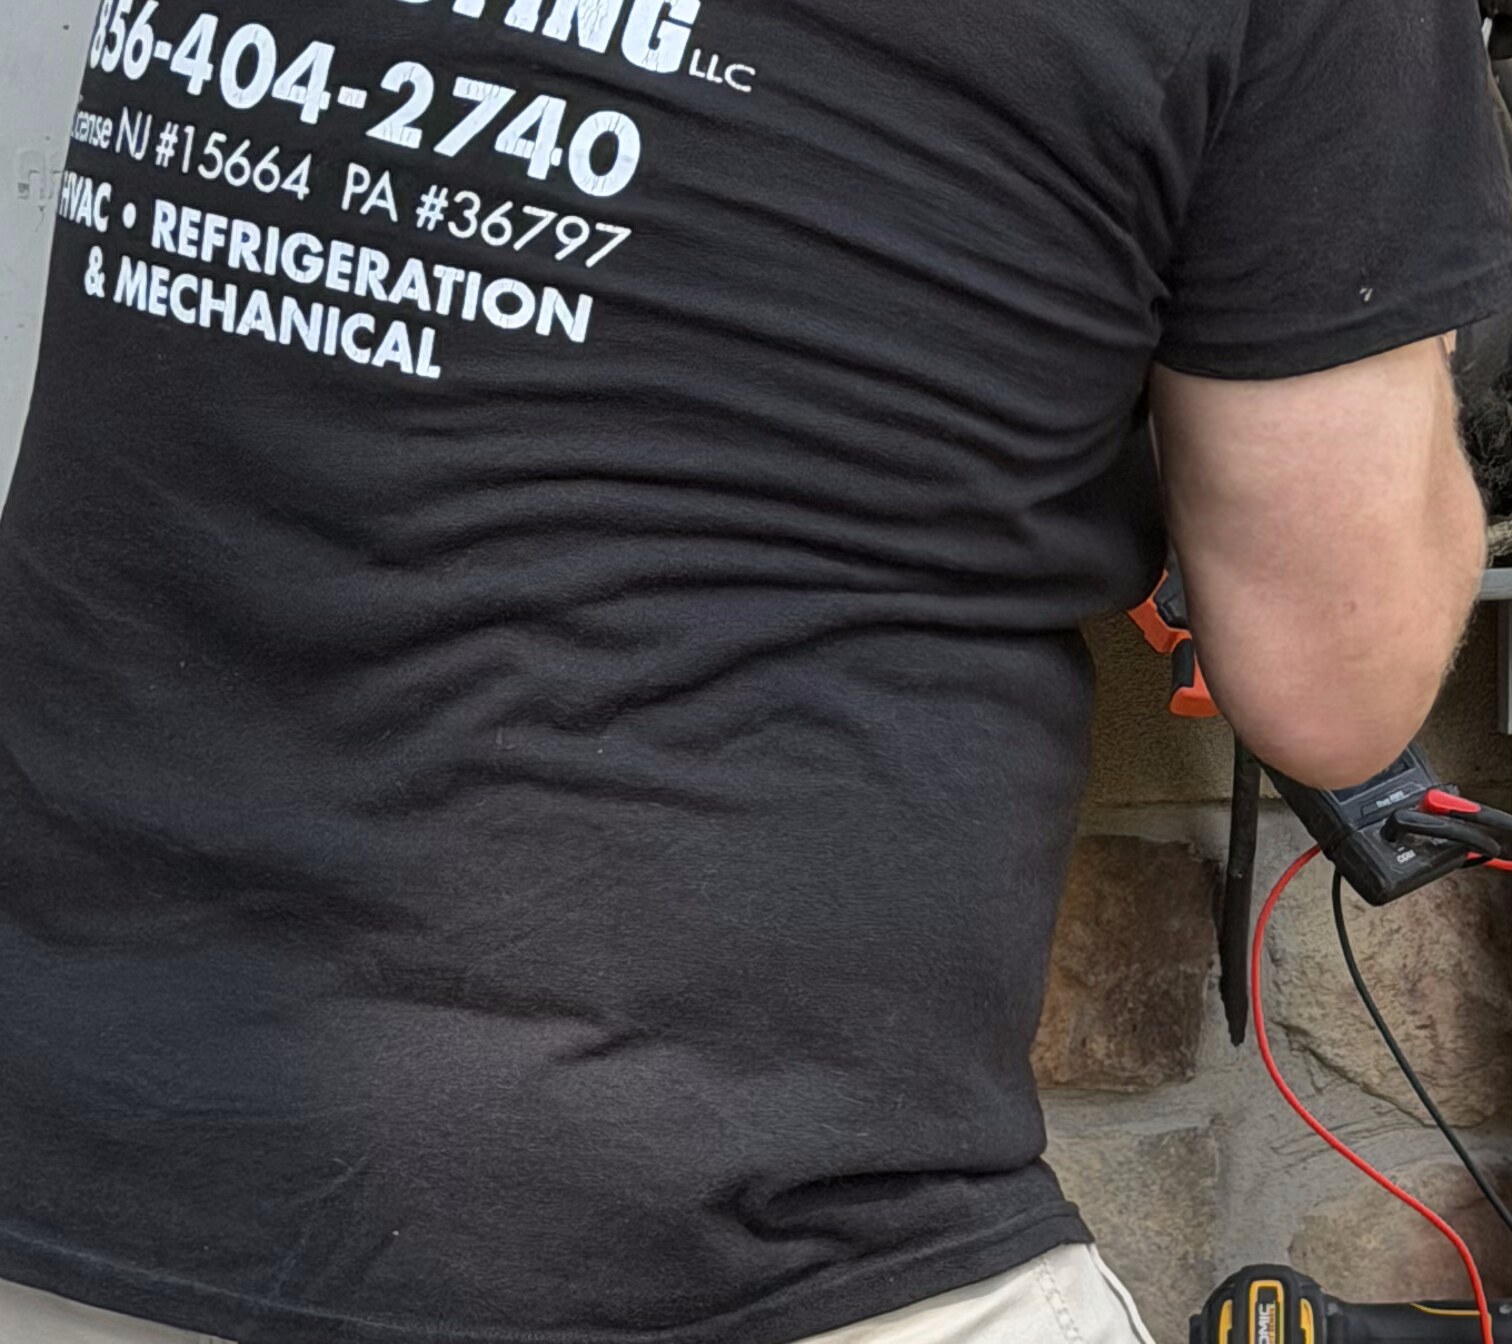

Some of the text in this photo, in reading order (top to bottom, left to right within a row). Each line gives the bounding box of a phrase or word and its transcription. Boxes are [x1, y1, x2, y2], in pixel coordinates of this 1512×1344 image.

[688, 48, 756, 93] LLC
[60, 169, 593, 343] HVAC REFRIGERATION
[115, 106, 153, 161] NJ
[155, 121, 312, 202] #15664
[341, 162, 398, 222] PA
[415, 184, 632, 268] #36797
[84, 245, 441, 379] & MECHANICAL
